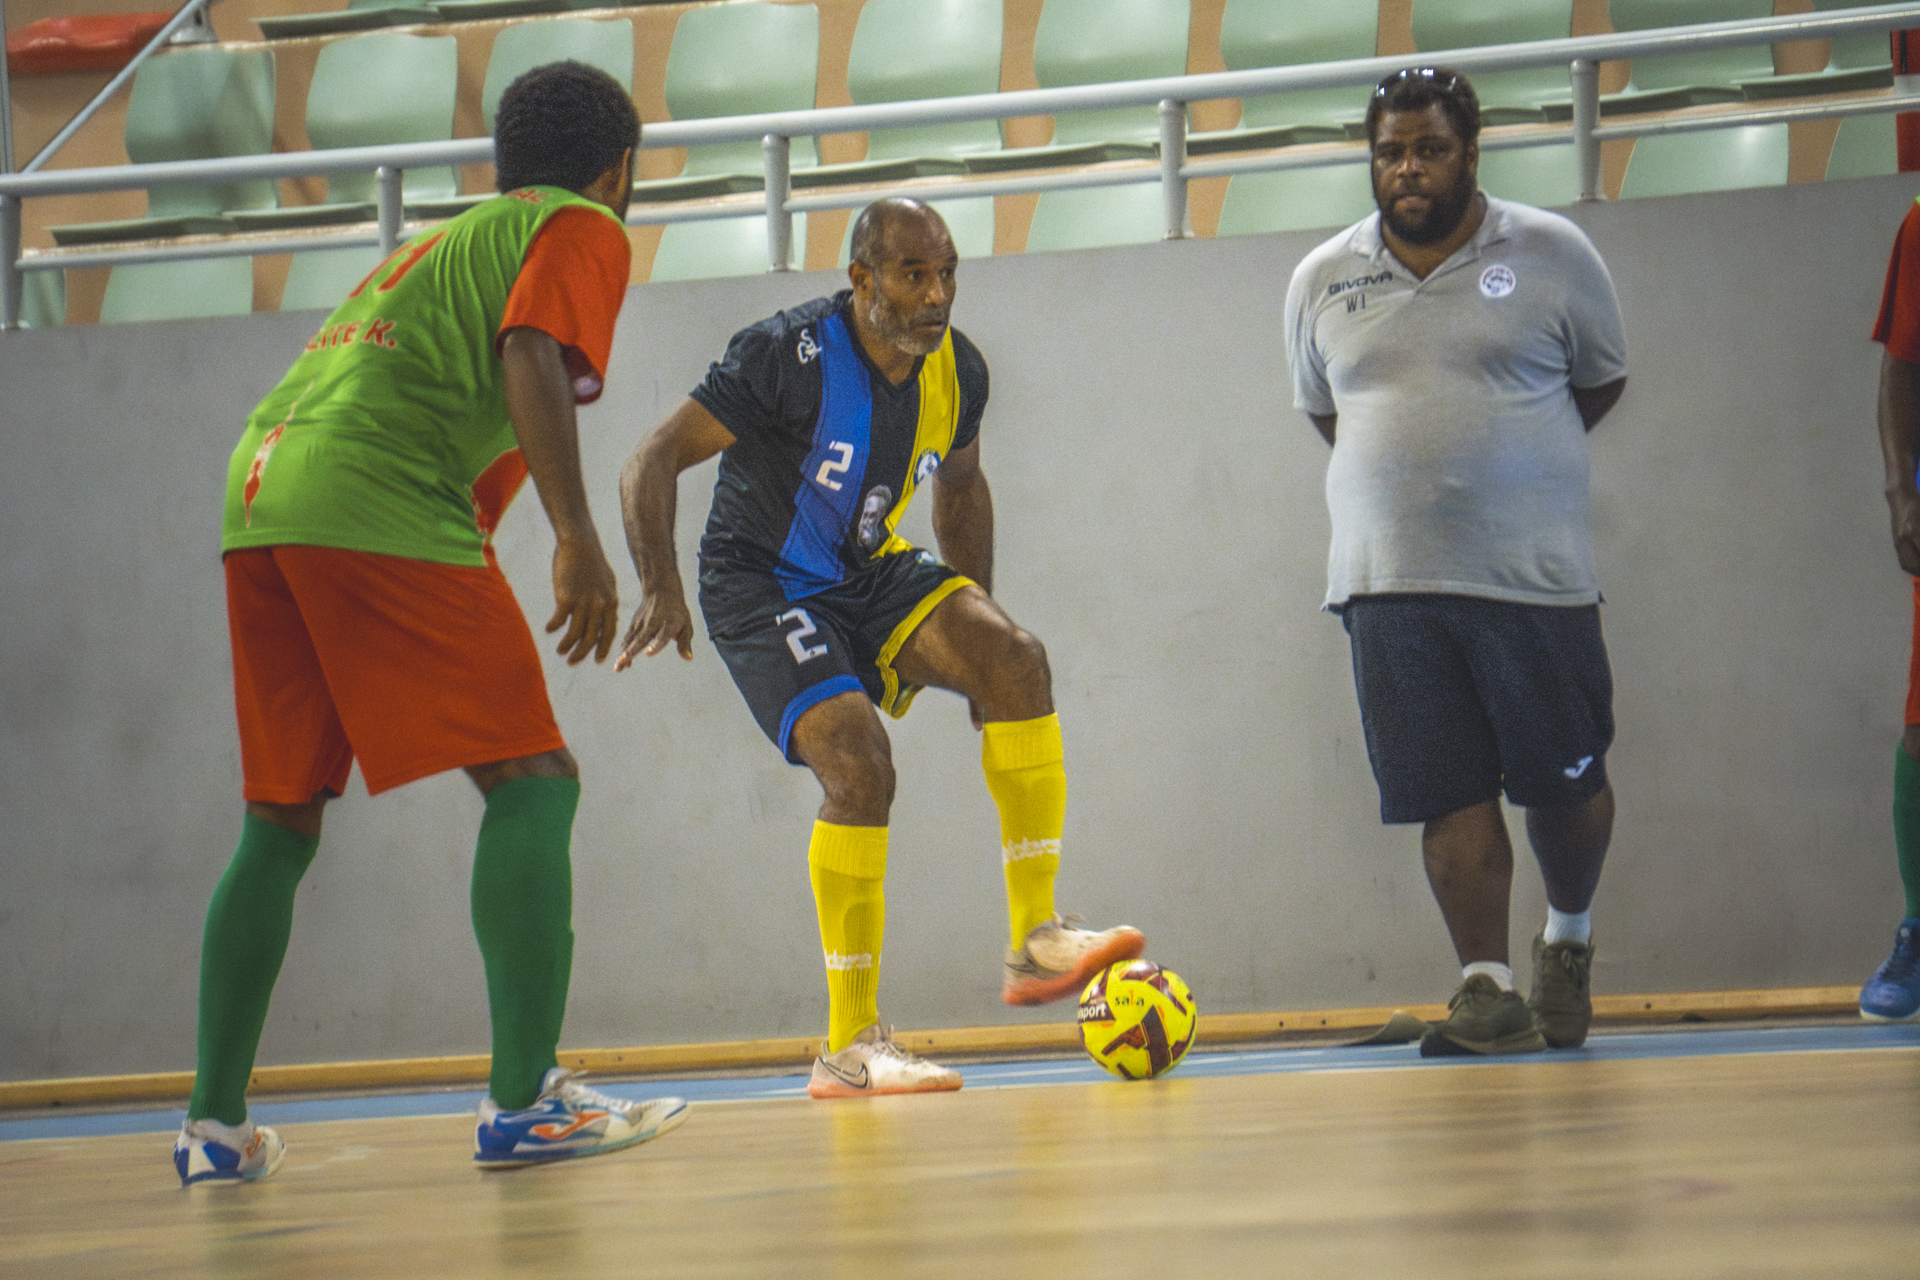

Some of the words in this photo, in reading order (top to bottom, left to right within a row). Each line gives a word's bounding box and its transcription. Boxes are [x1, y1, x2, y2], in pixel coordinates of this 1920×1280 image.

[1328, 270, 1393, 296] GIVOVA
[815, 440, 854, 491] 2
[775, 607, 828, 665] 2
[1115, 989, 1145, 1007] sala
